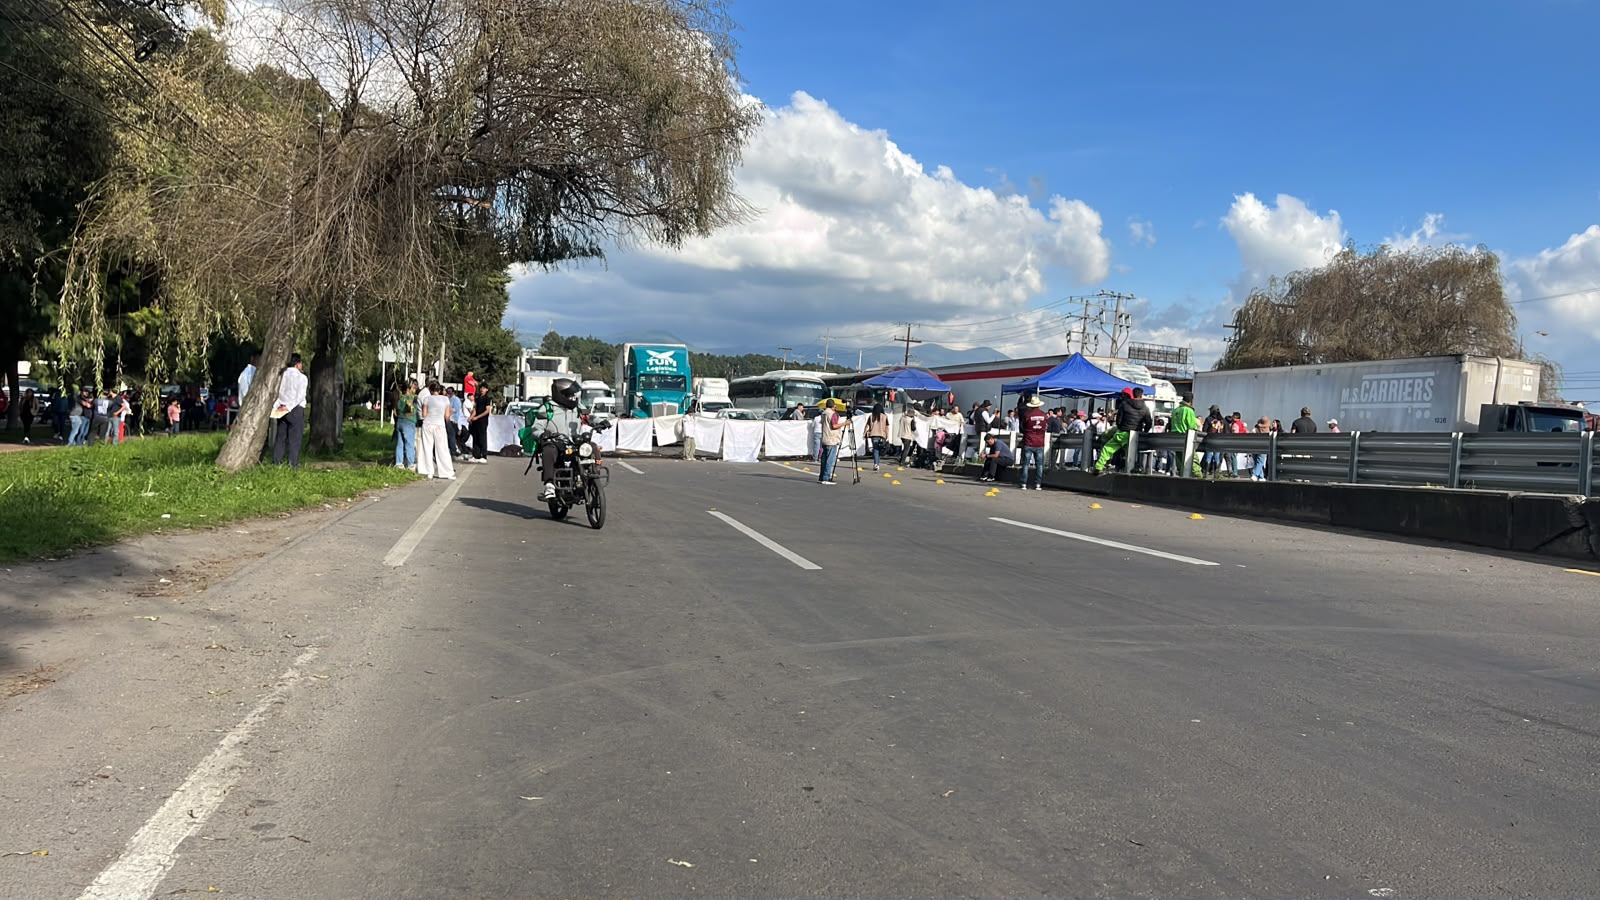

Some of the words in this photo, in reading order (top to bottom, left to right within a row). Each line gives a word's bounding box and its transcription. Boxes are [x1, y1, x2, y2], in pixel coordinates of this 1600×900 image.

[646, 357, 677, 367] TUM
[1341, 387, 1360, 403] M.S.
[1360, 378, 1434, 402] CARRIERS
